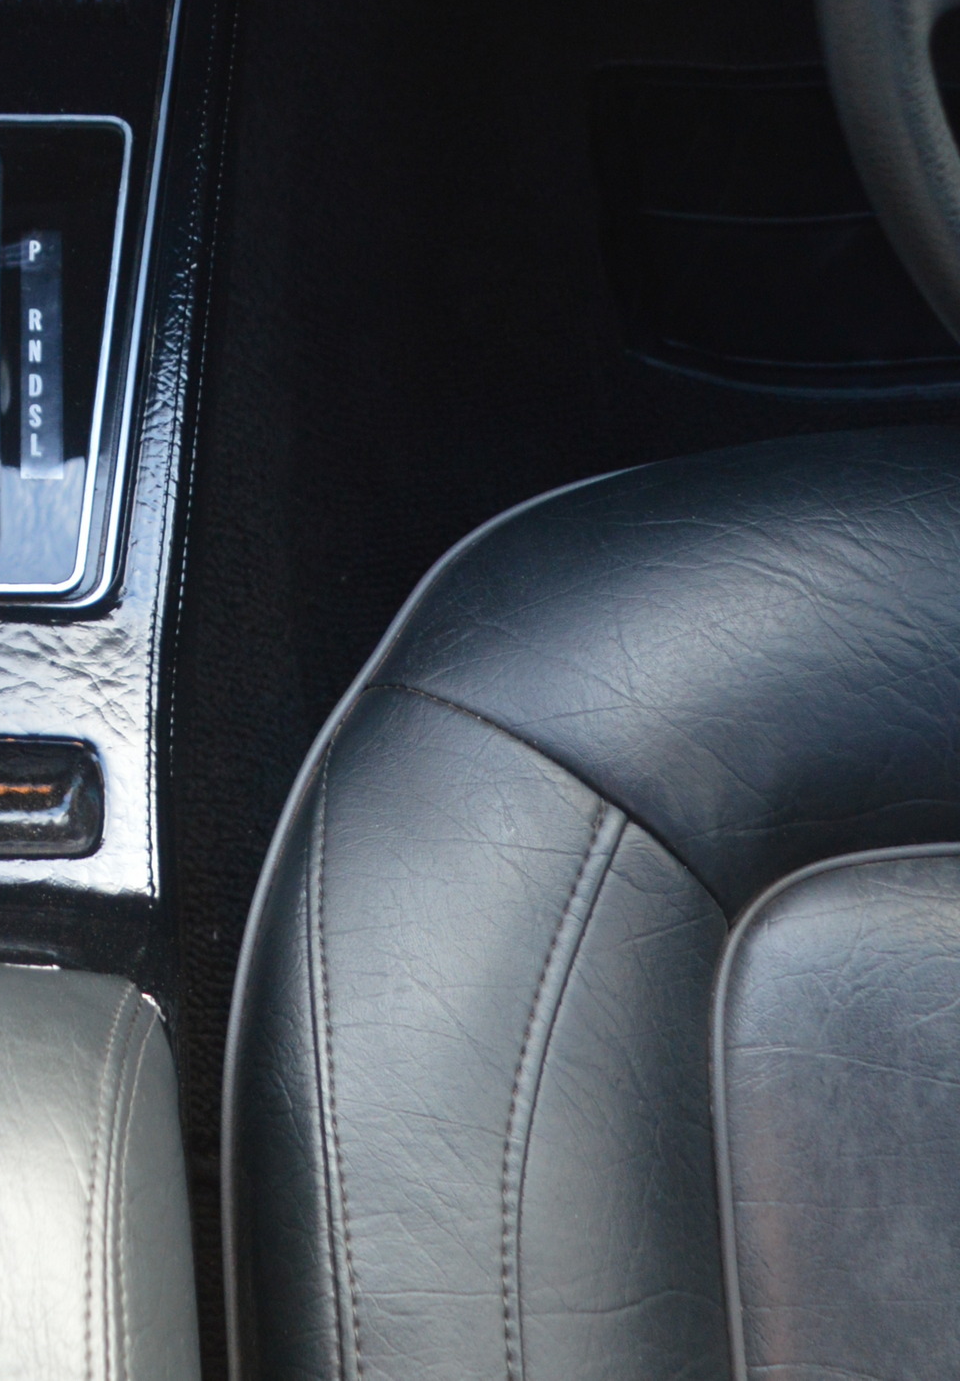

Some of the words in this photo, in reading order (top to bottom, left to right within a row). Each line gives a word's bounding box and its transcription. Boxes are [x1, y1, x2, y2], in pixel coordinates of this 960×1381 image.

[28, 239, 42, 262] P
[28, 308, 43, 332] R
[28, 339, 43, 363] N
[28, 373, 43, 398] D
[28, 403, 43, 429] S
[29, 432, 42, 457] L
